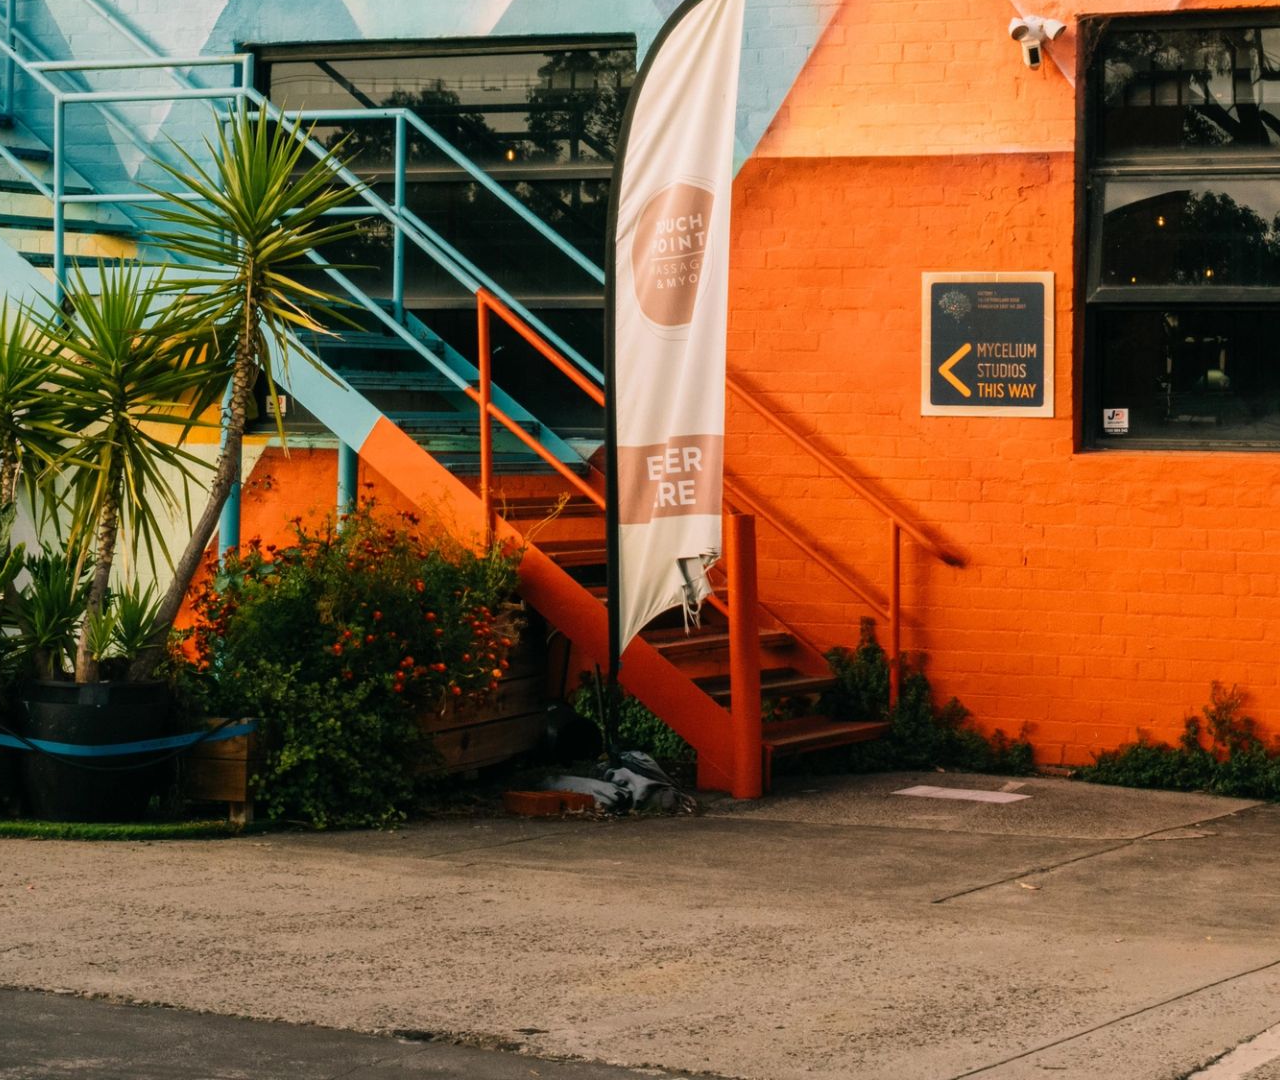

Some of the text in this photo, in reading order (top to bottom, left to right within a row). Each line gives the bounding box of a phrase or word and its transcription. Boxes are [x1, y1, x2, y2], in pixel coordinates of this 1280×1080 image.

[977, 343, 1037, 358] MYCELIUM
[977, 363, 1027, 378] STUDIOS
[977, 382, 1037, 398] THIS WAY
